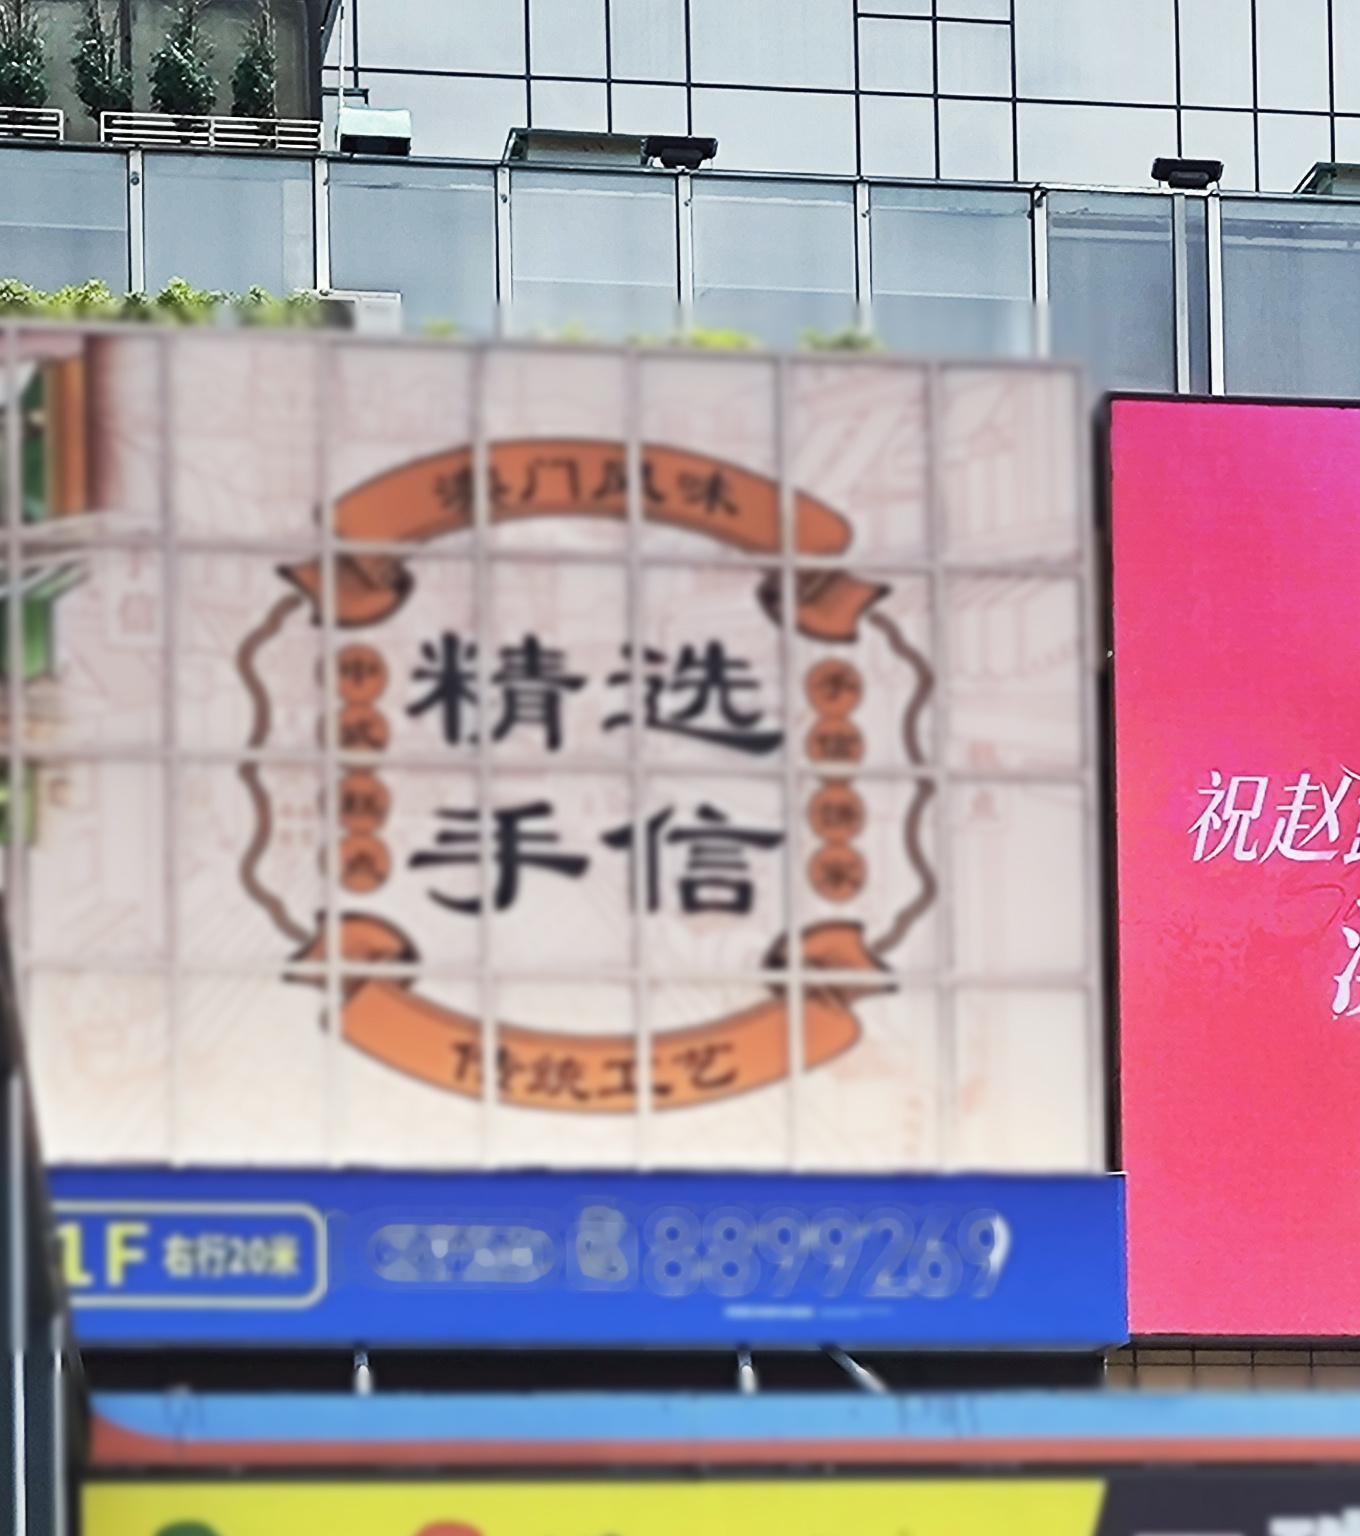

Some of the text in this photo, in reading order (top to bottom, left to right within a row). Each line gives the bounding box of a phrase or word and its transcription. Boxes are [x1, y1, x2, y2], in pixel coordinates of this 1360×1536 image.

[406, 629, 788, 755] 精选
[407, 800, 788, 918] 手信
[449, 1035, 741, 1102] 传统工艺
[56, 1221, 150, 1288] 1F
[643, 1206, 1012, 1297] 8899269
